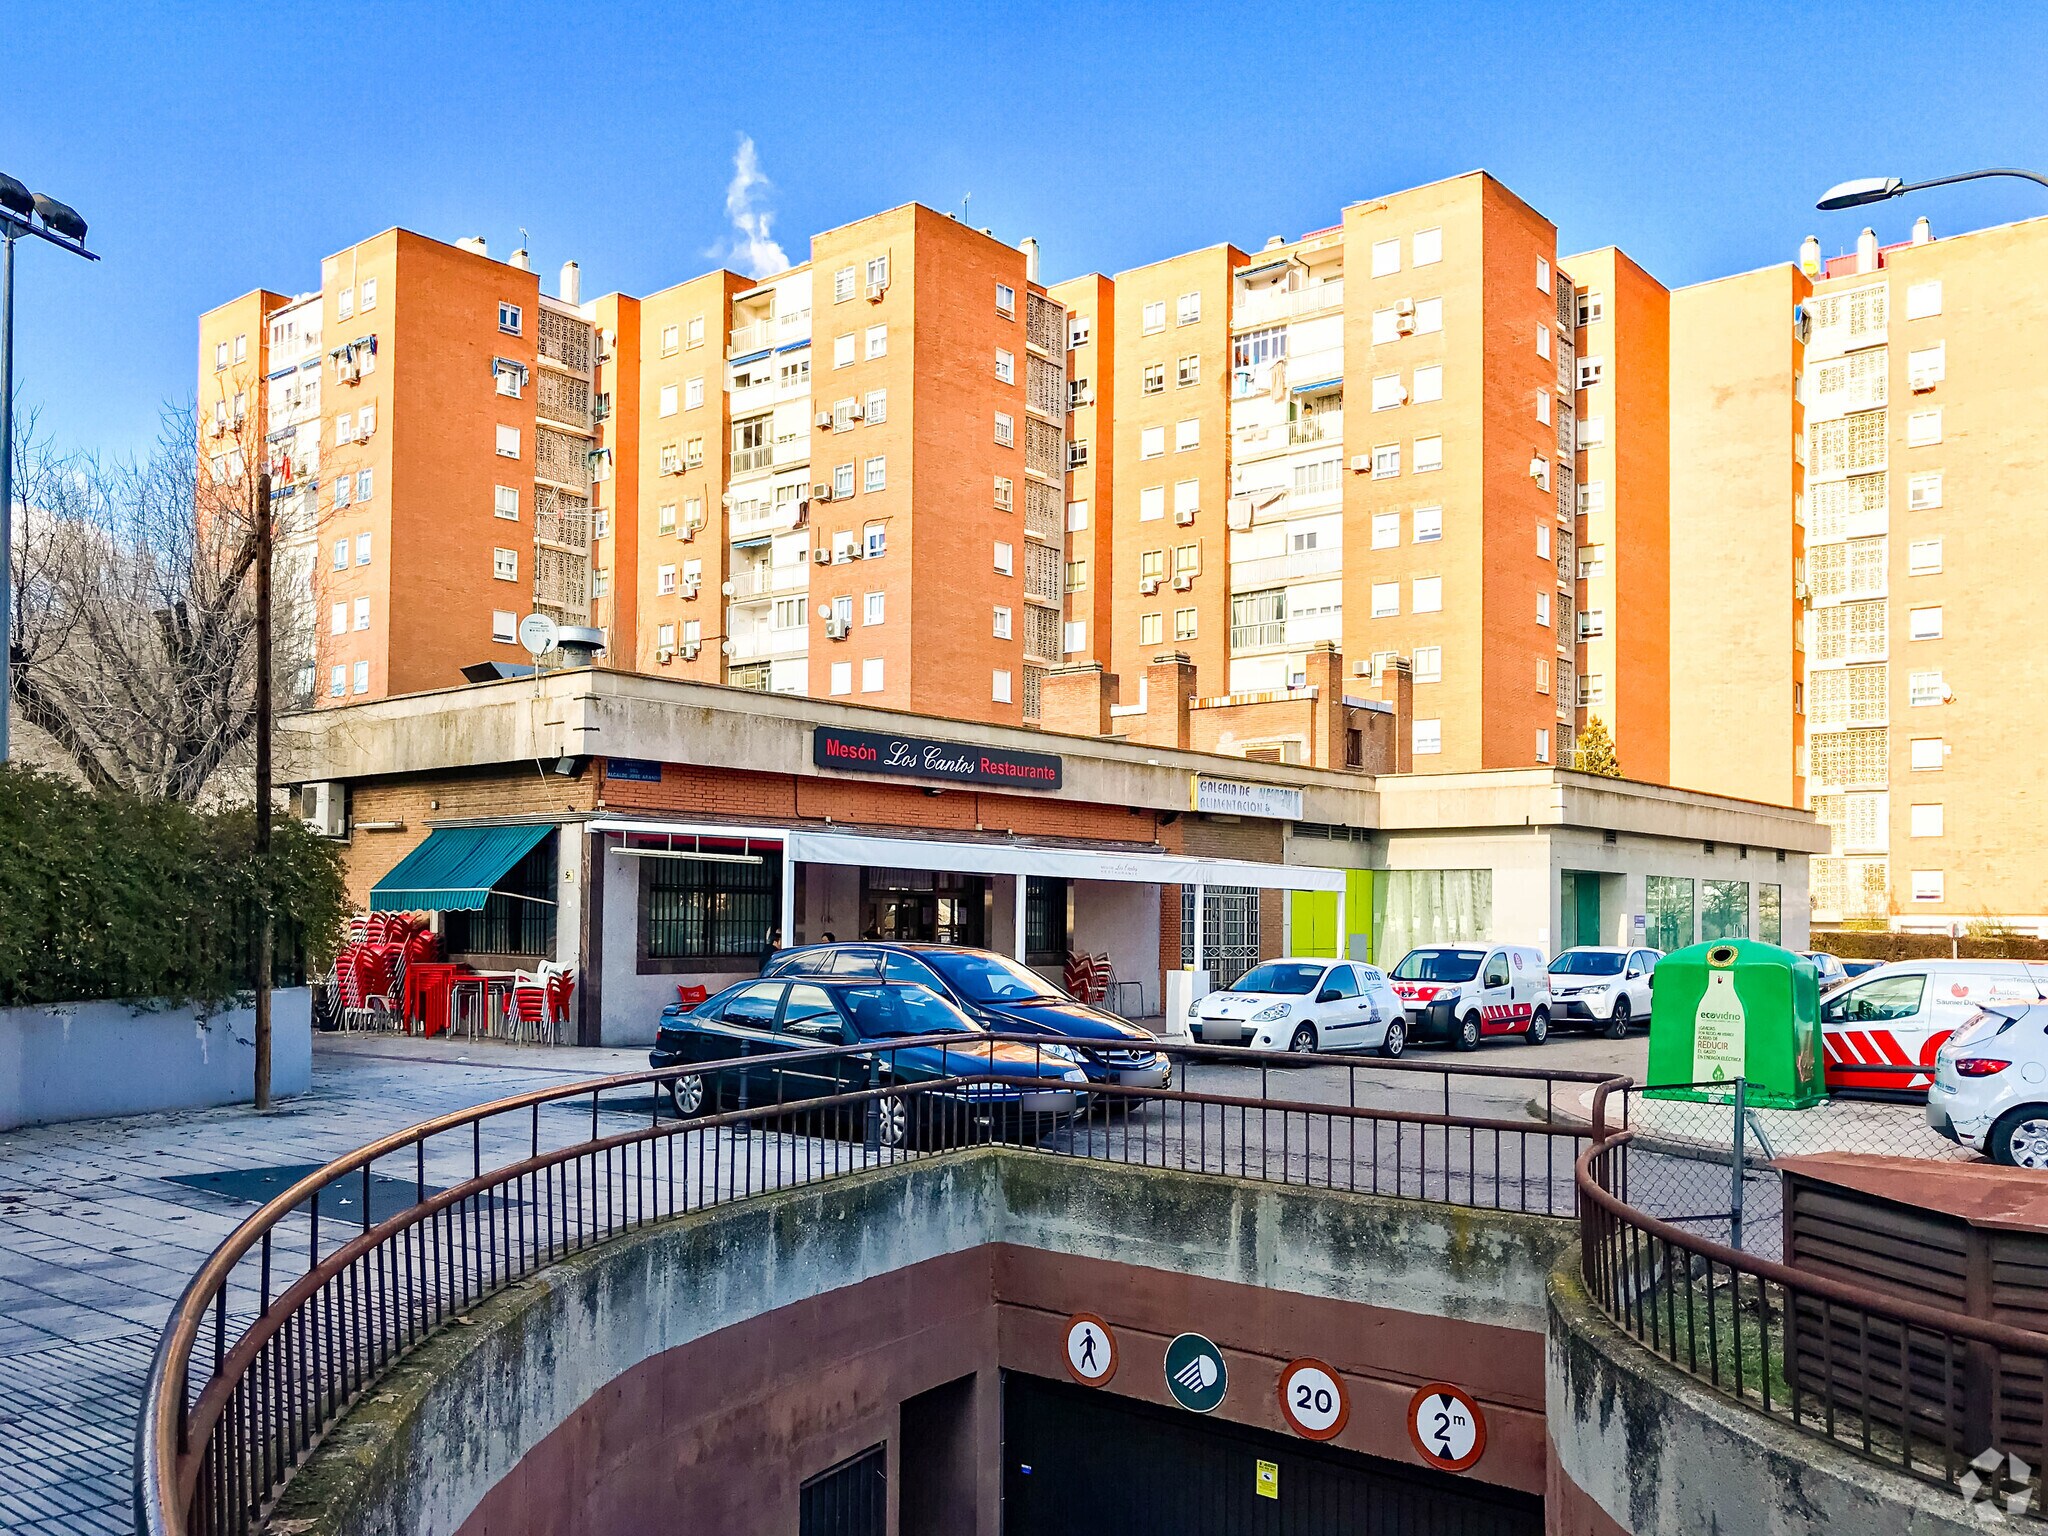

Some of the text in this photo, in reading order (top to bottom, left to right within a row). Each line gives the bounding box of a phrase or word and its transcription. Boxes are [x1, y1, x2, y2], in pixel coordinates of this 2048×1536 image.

[826, 739, 1056, 781] Mesón Los Cantos Restaurante
[1200, 781, 1251, 796] GALERIA DE
[1364, 970, 1381, 981] OTIS
[1220, 996, 1259, 1004] OTIS
[1700, 1011, 1741, 1020] ecovidrio
[1698, 1040, 1728, 1050] REDUCIR
[1296, 1385, 1333, 1413] 20
